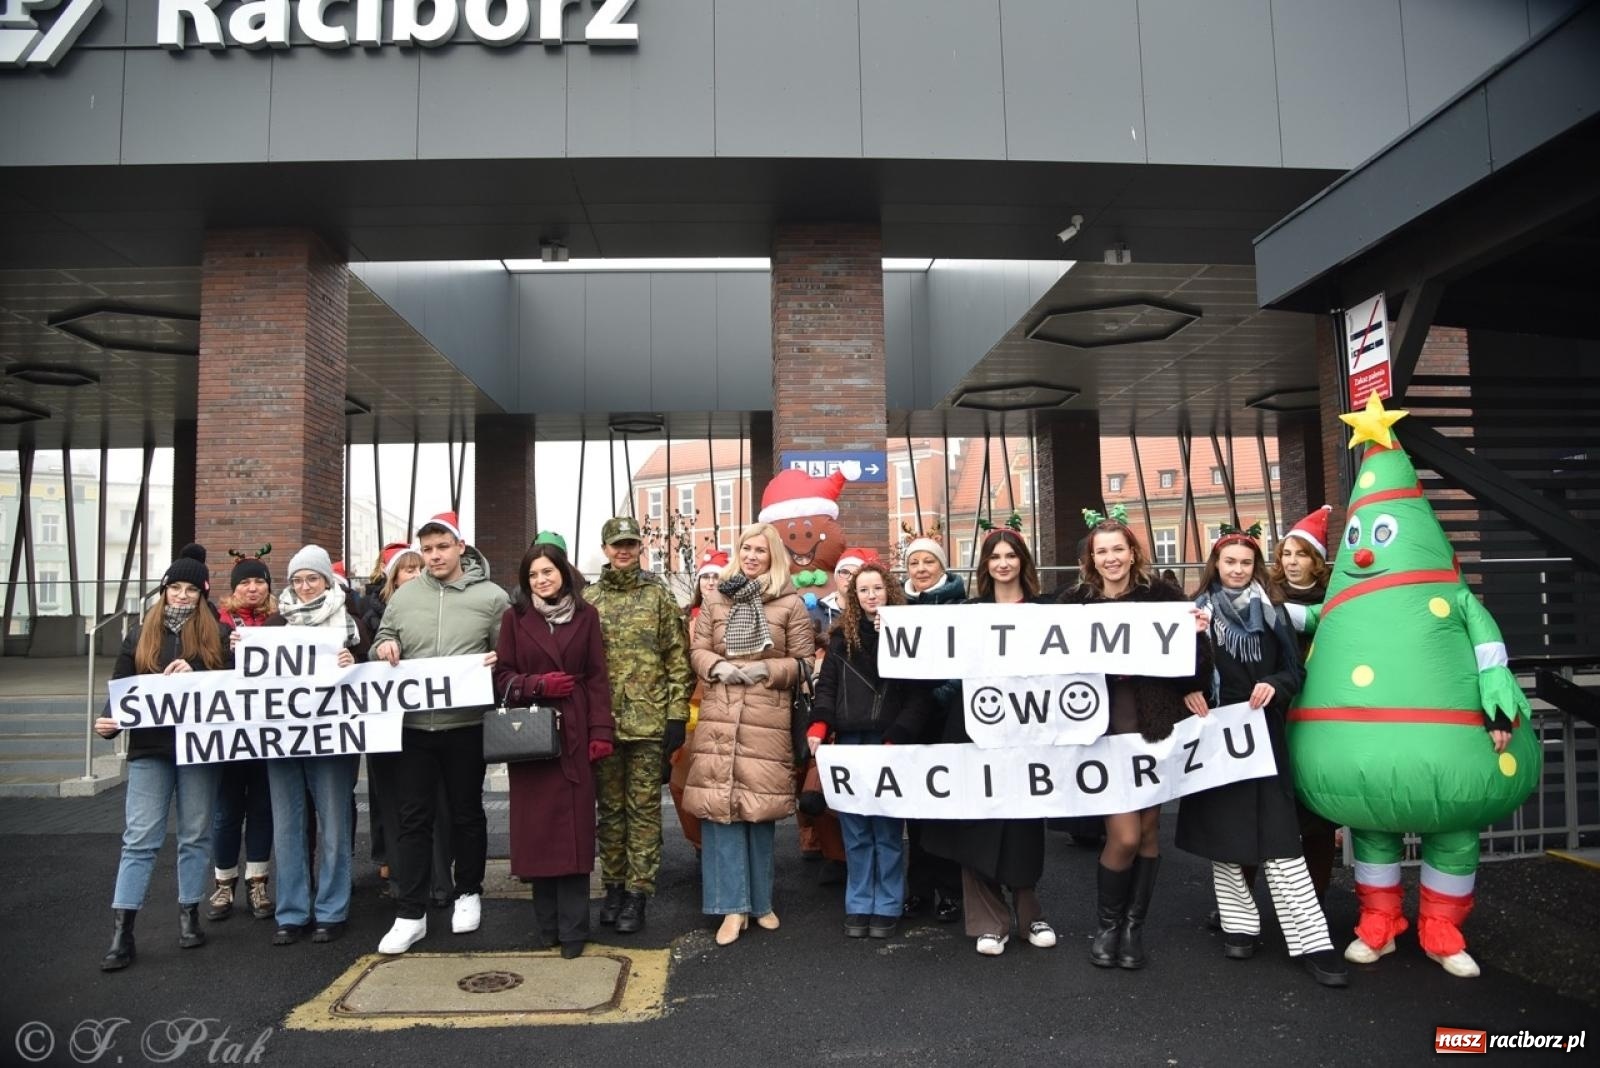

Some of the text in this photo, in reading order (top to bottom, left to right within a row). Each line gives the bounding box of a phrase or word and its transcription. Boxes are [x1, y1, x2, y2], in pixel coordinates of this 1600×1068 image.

[243, 644, 316, 678] DNI
[885, 622, 1180, 659] WITAMY
[119, 676, 452, 728] ŚWIATECZNYCH
[185, 713, 367, 763] MARZEŃ
[830, 722, 1257, 799] RACIBORZU
